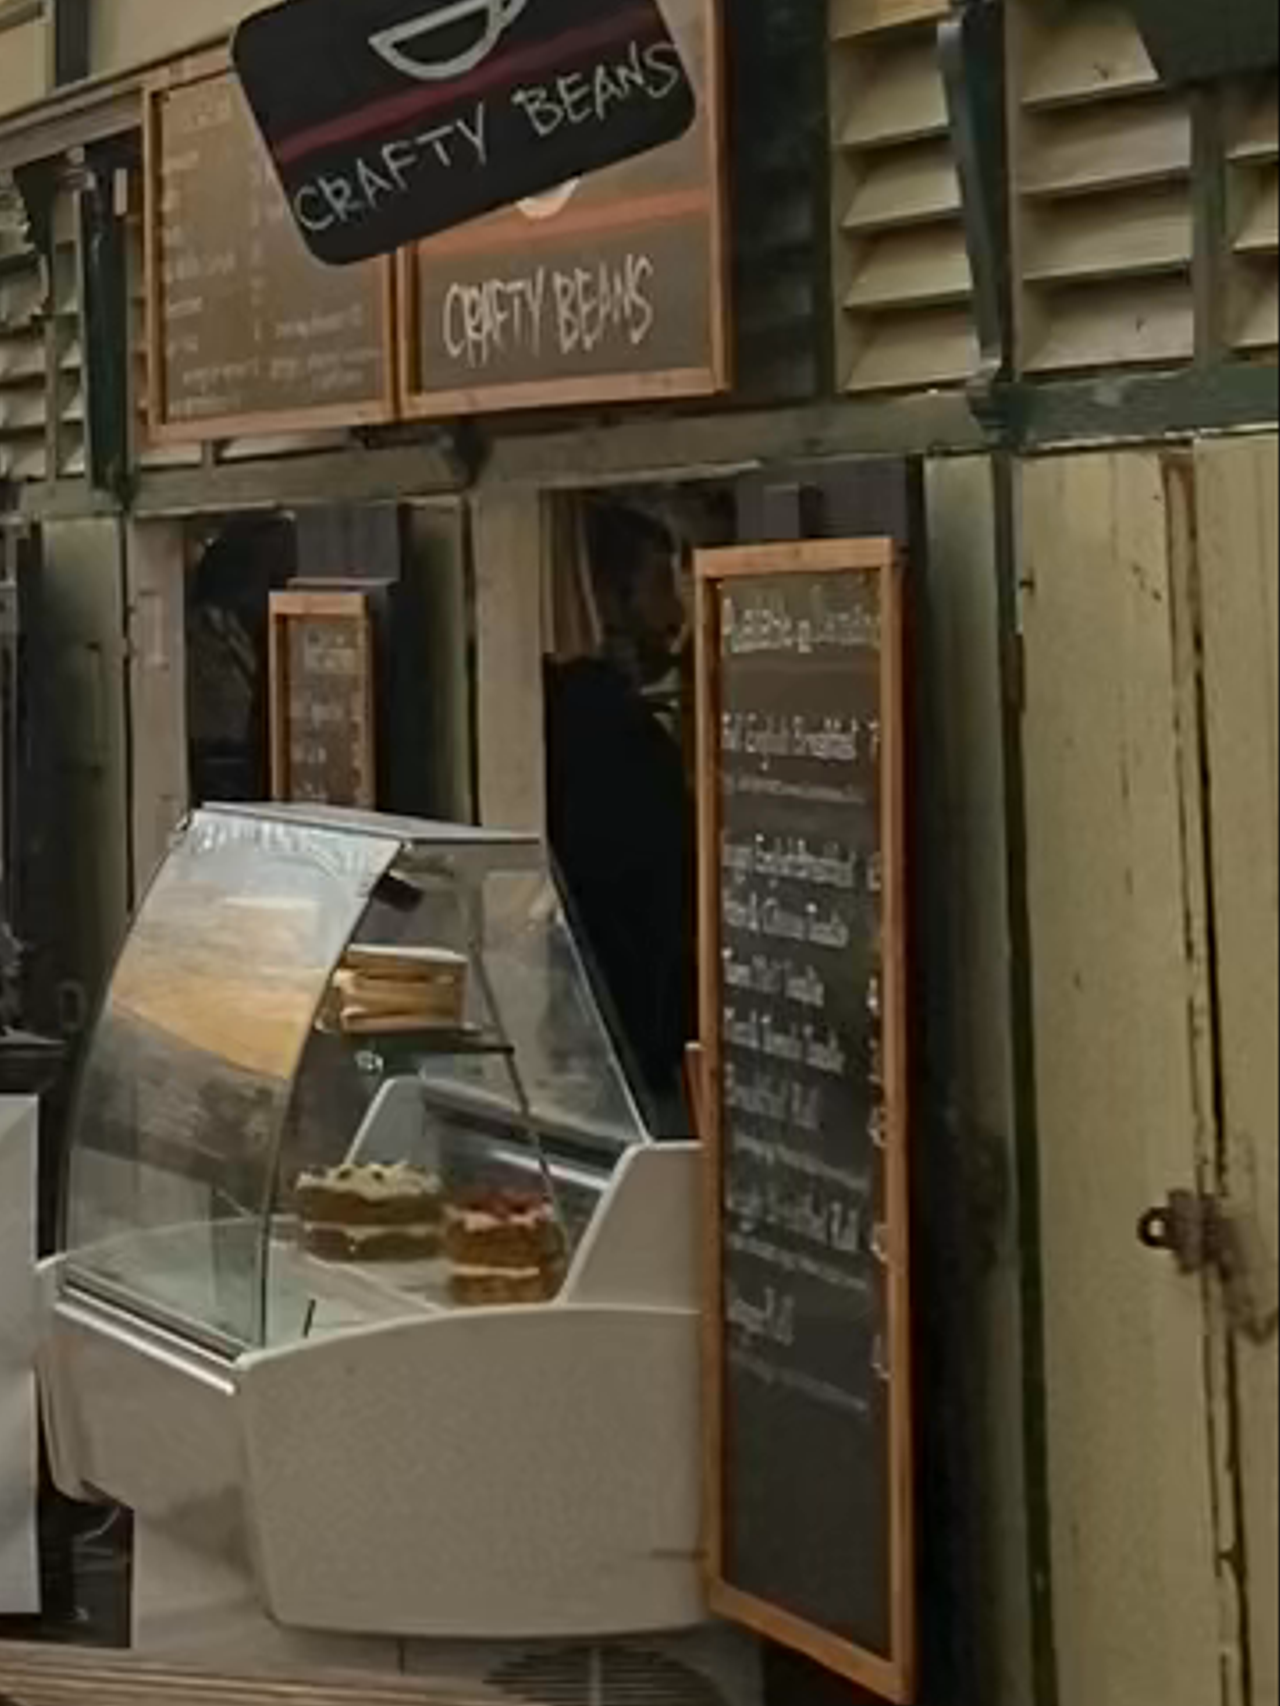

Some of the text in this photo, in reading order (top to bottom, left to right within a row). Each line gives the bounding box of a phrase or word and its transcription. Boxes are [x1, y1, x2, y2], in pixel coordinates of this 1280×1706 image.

[293, 102, 488, 232] CRAFTY
[510, 40, 679, 137] BEANS
[443, 266, 547, 367] CRAFTY
[552, 253, 654, 357] BEANS
